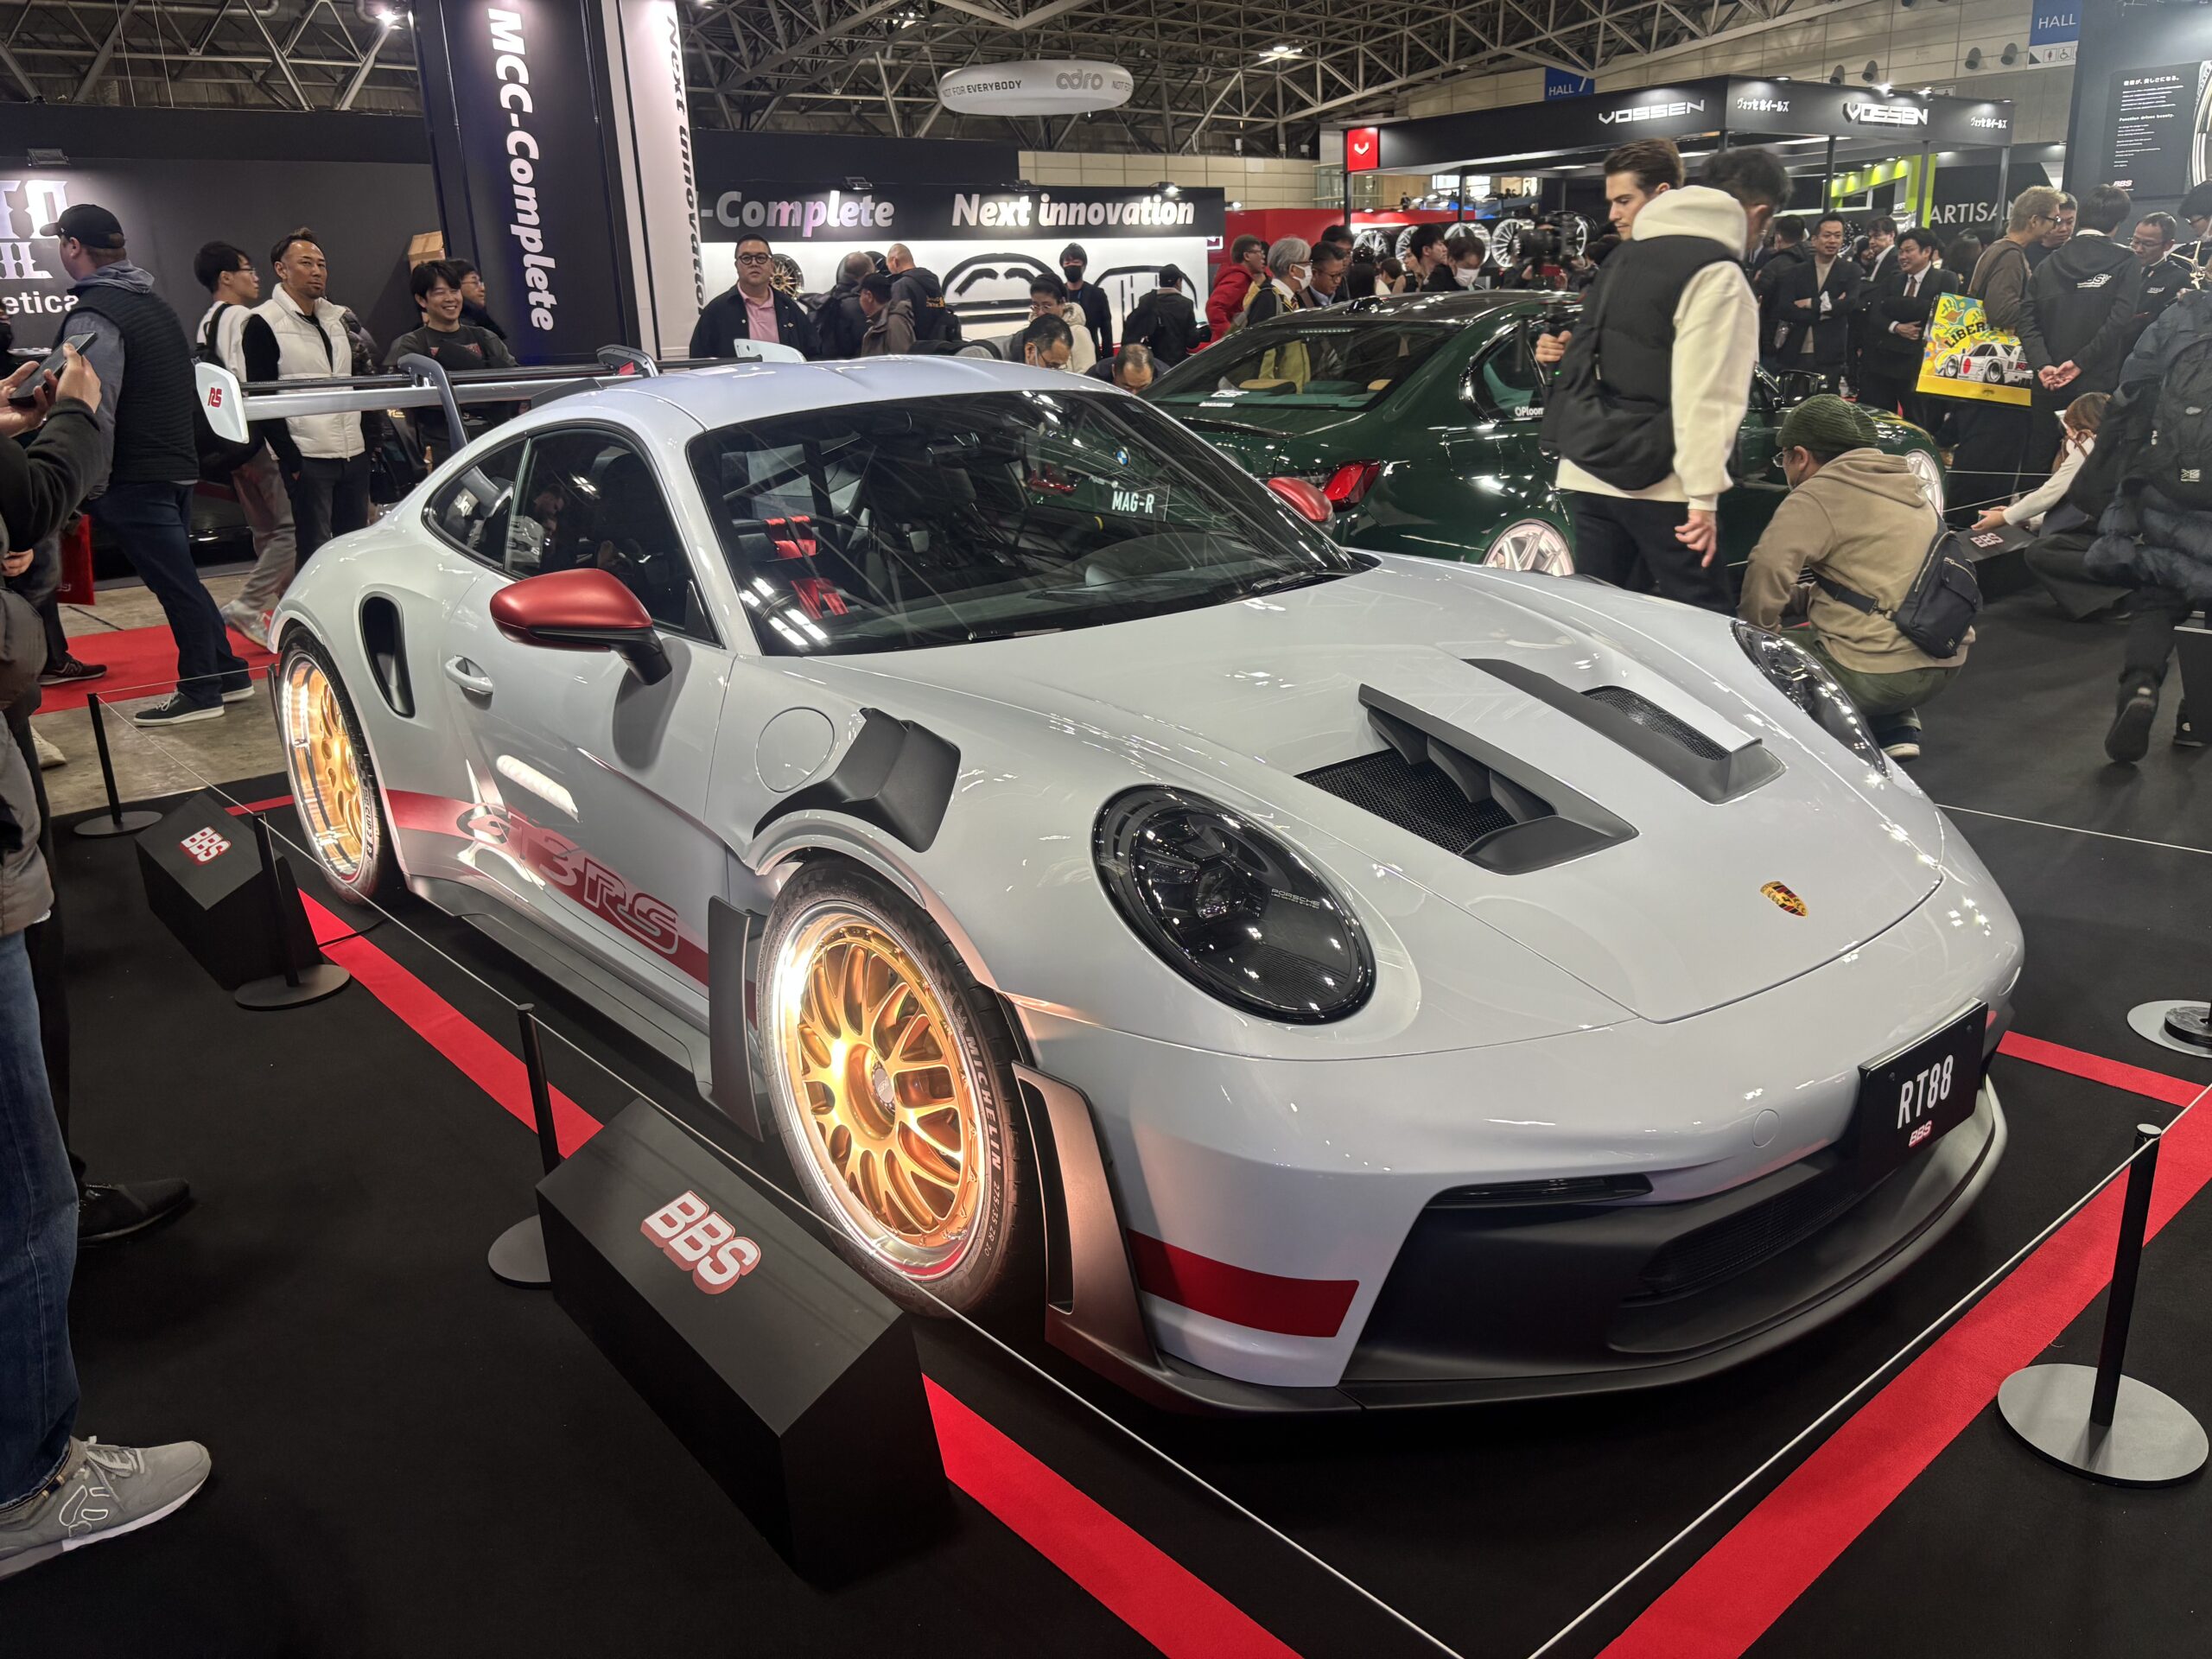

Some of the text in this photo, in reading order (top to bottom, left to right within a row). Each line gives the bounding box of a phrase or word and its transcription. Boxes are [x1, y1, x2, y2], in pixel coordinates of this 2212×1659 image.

[2038, 14, 2076, 29] HALL
[667, 16, 686, 116] Next
[952, 86, 966, 96] FOR
[967, 79, 1022, 93] EVERYBODY
[1548, 84, 1574, 96] HALL
[1598, 99, 1705, 124] VOSSEN
[1843, 102, 1929, 125] VOSSEN
[487, 8, 557, 331] MCC-Complete
[951, 194, 1030, 227] Next
[1039, 195, 1194, 226] innovation
[207, 387, 222, 408] RS
[1112, 491, 1154, 513] MAG-R
[1970, 532, 2004, 548] BBS
[180, 825, 232, 864] BBS
[1271, 888, 1319, 906] PORSCHE
[966, 1036, 1001, 1172] MICHELIN
[1897, 1054, 1954, 1129] RT88
[1908, 1120, 1933, 1147] BBS
[984, 1180, 1001, 1257] 275/35 ZR 20
[640, 1190, 761, 1294] BBS
